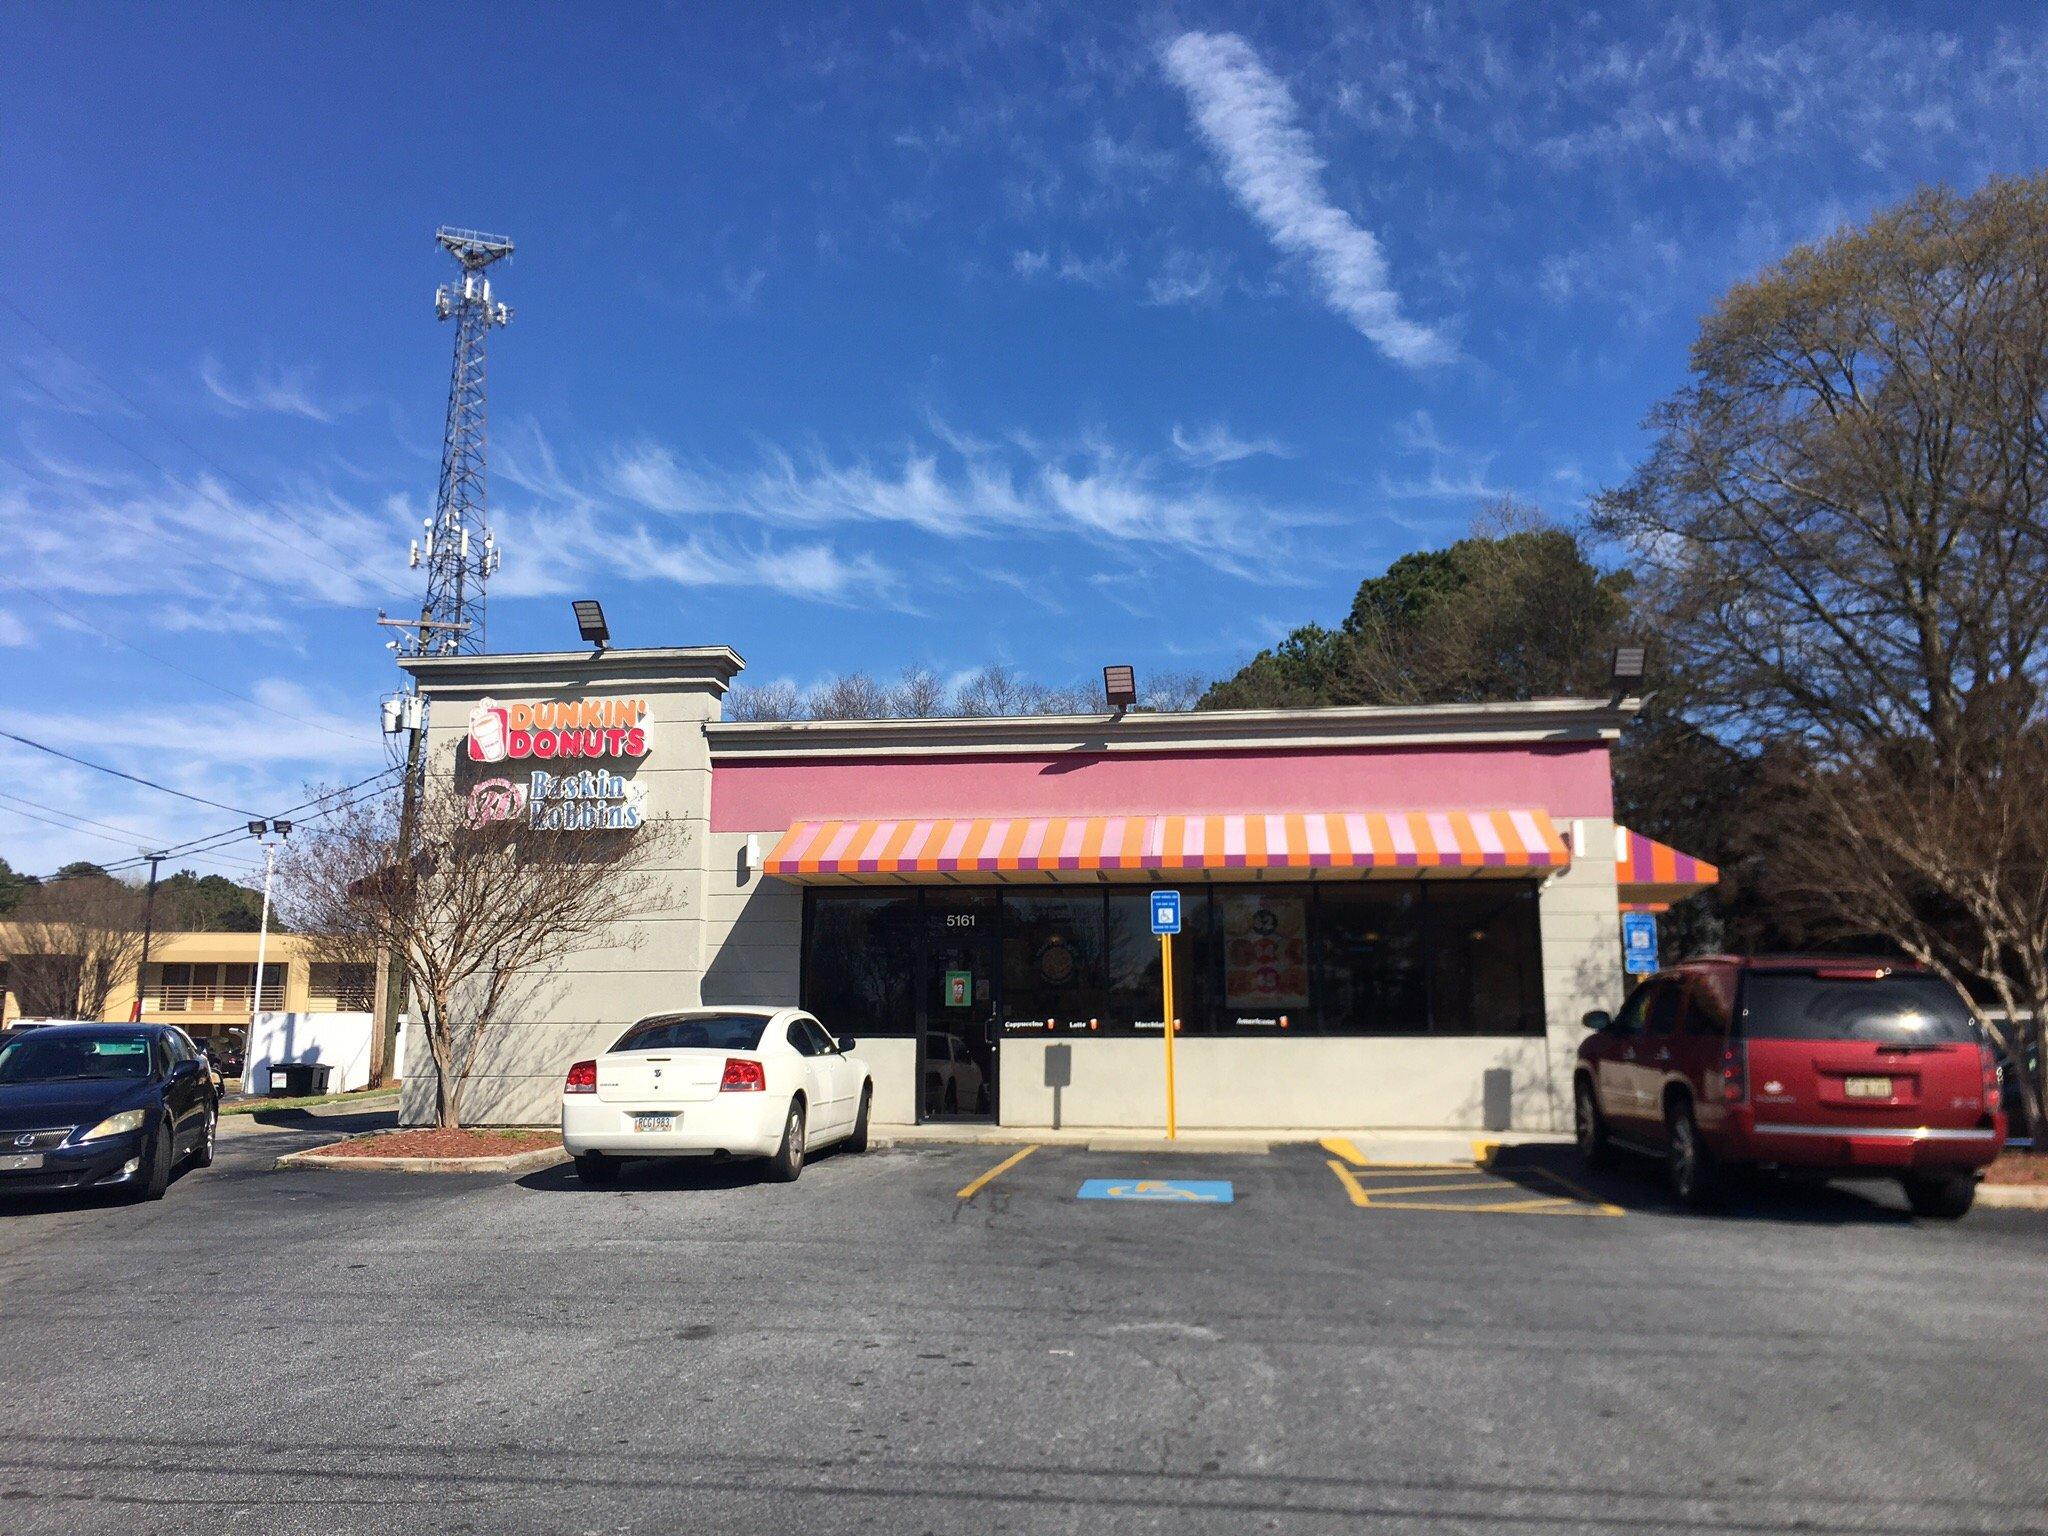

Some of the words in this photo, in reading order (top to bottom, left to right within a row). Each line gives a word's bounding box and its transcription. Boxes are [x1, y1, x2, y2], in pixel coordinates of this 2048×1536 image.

[509, 699, 646, 731] DUNKIN'
[507, 728, 645, 759] DONUTS
[530, 769, 626, 800] Baskin
[528, 800, 640, 831] Robbins
[947, 914, 975, 927] 5161
